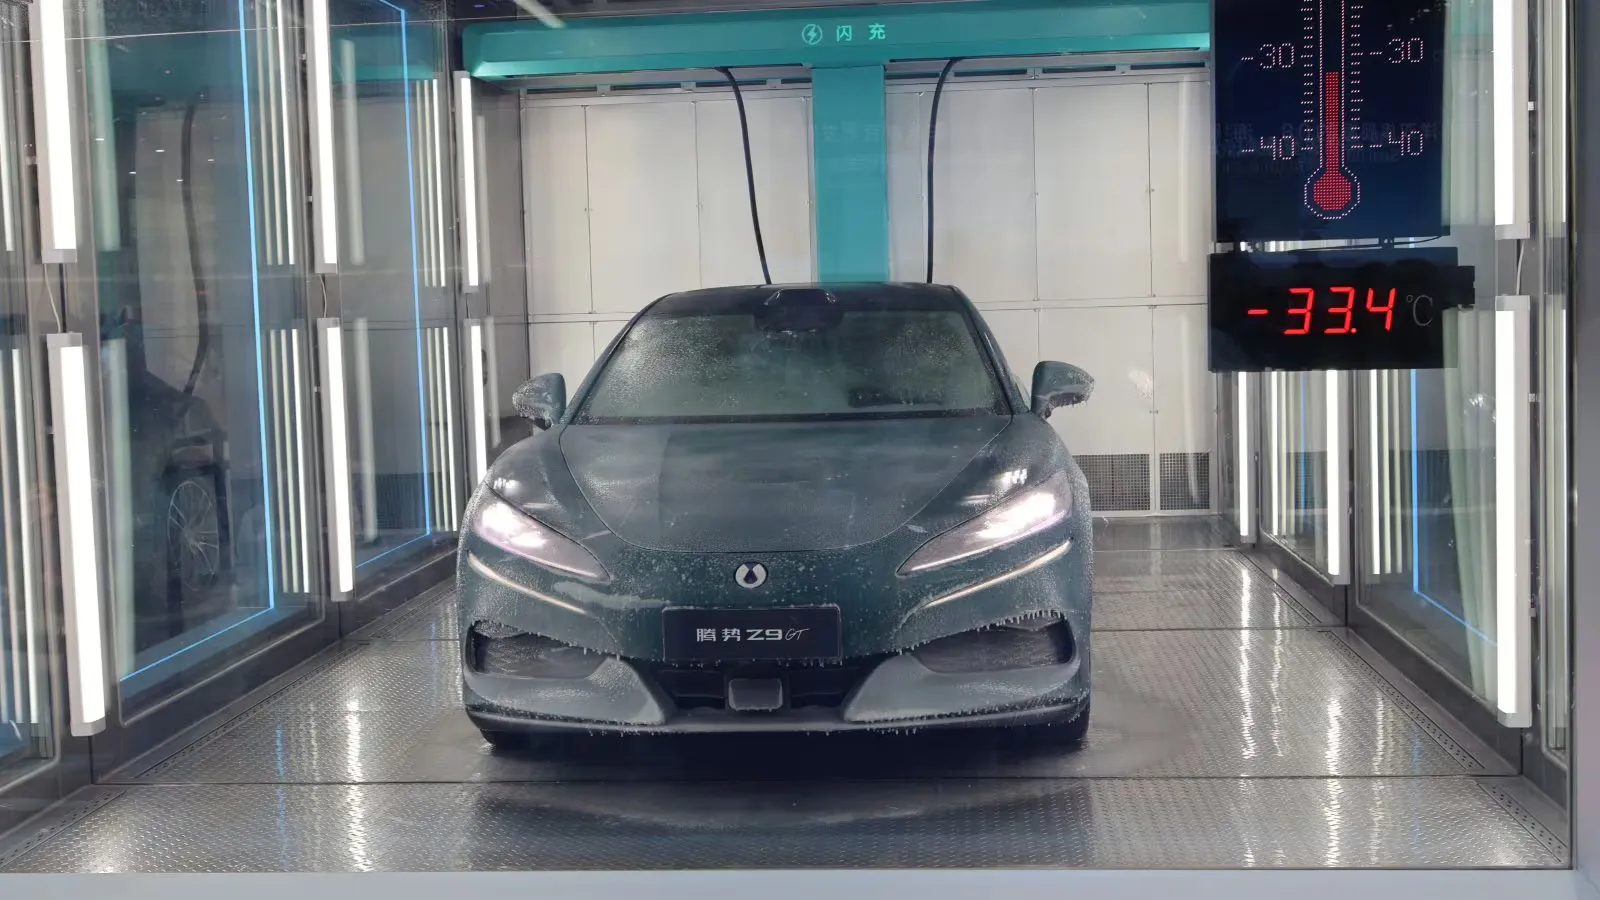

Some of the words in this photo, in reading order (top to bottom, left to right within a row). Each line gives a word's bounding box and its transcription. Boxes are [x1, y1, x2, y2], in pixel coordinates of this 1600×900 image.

[836, 23, 886, 42] 闪充
[1240, 42, 1295, 69] -30
[1369, 37, 1424, 64] -30
[1241, 135, 1296, 161] -40
[1369, 130, 1424, 156] -40
[696, 628, 741, 642] 腾势
